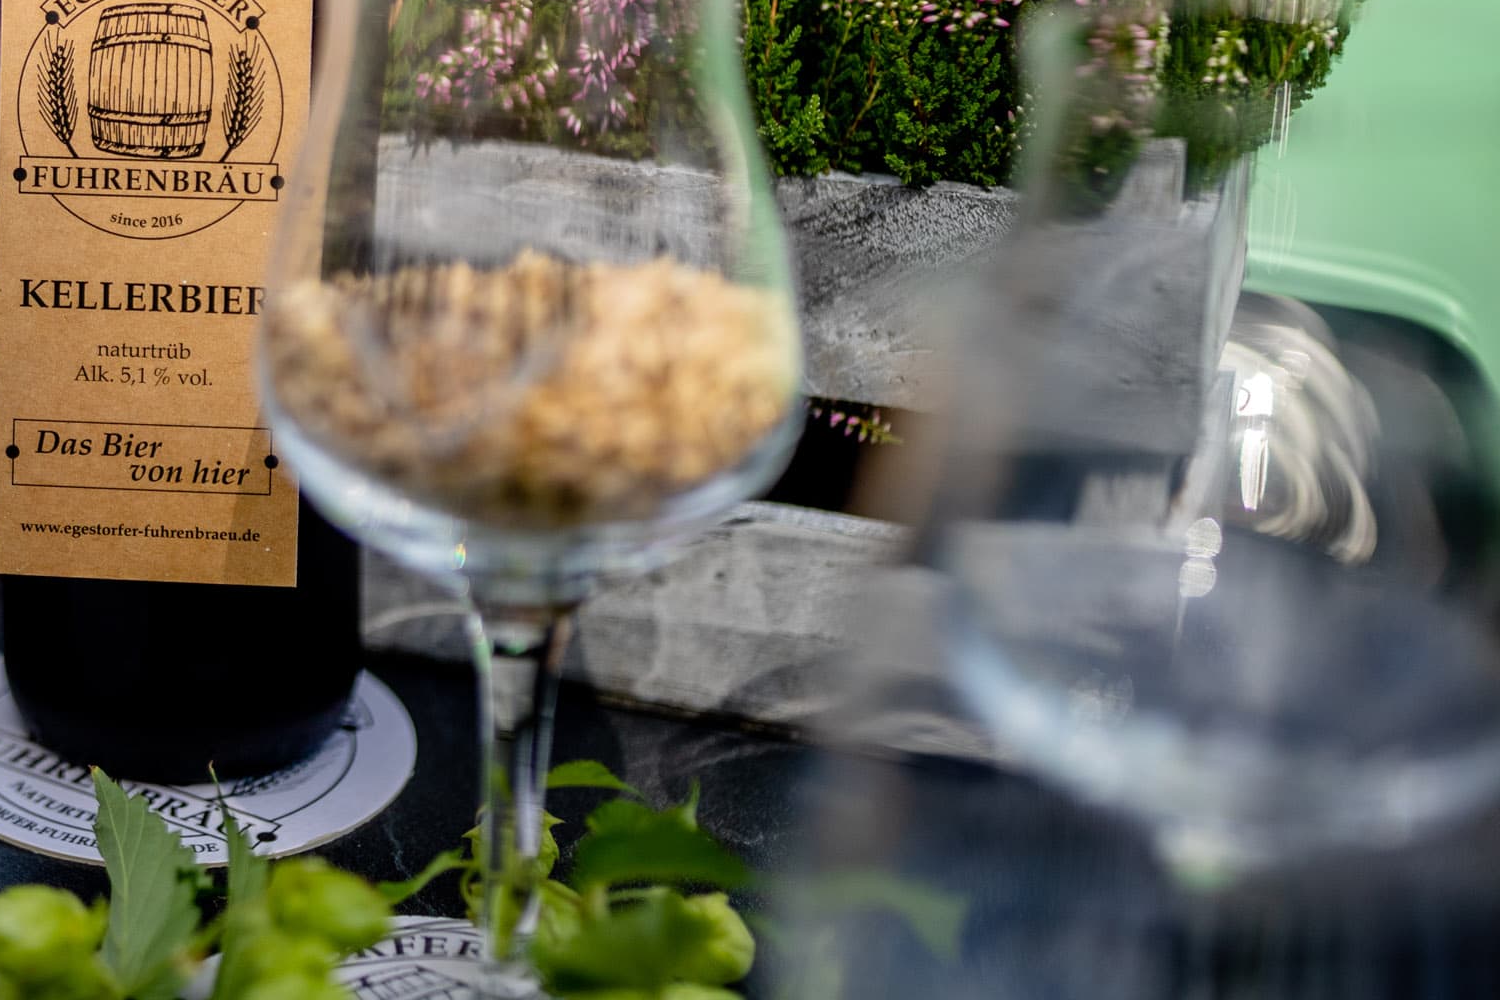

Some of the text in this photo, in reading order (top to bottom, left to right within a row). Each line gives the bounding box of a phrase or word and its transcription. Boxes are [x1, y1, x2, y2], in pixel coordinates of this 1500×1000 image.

[31, 164, 265, 195] FUHRENBRÄU
[109, 211, 184, 229] since 2016
[97, 342, 192, 361] naturtrüb
[73, 364, 213, 387] Alk. 5,1 % vol.
[34, 429, 163, 459] Das Bier
[129, 459, 251, 486] von hier
[19, 520, 262, 544] www.egestorfer-fuhrenbraeu.de
